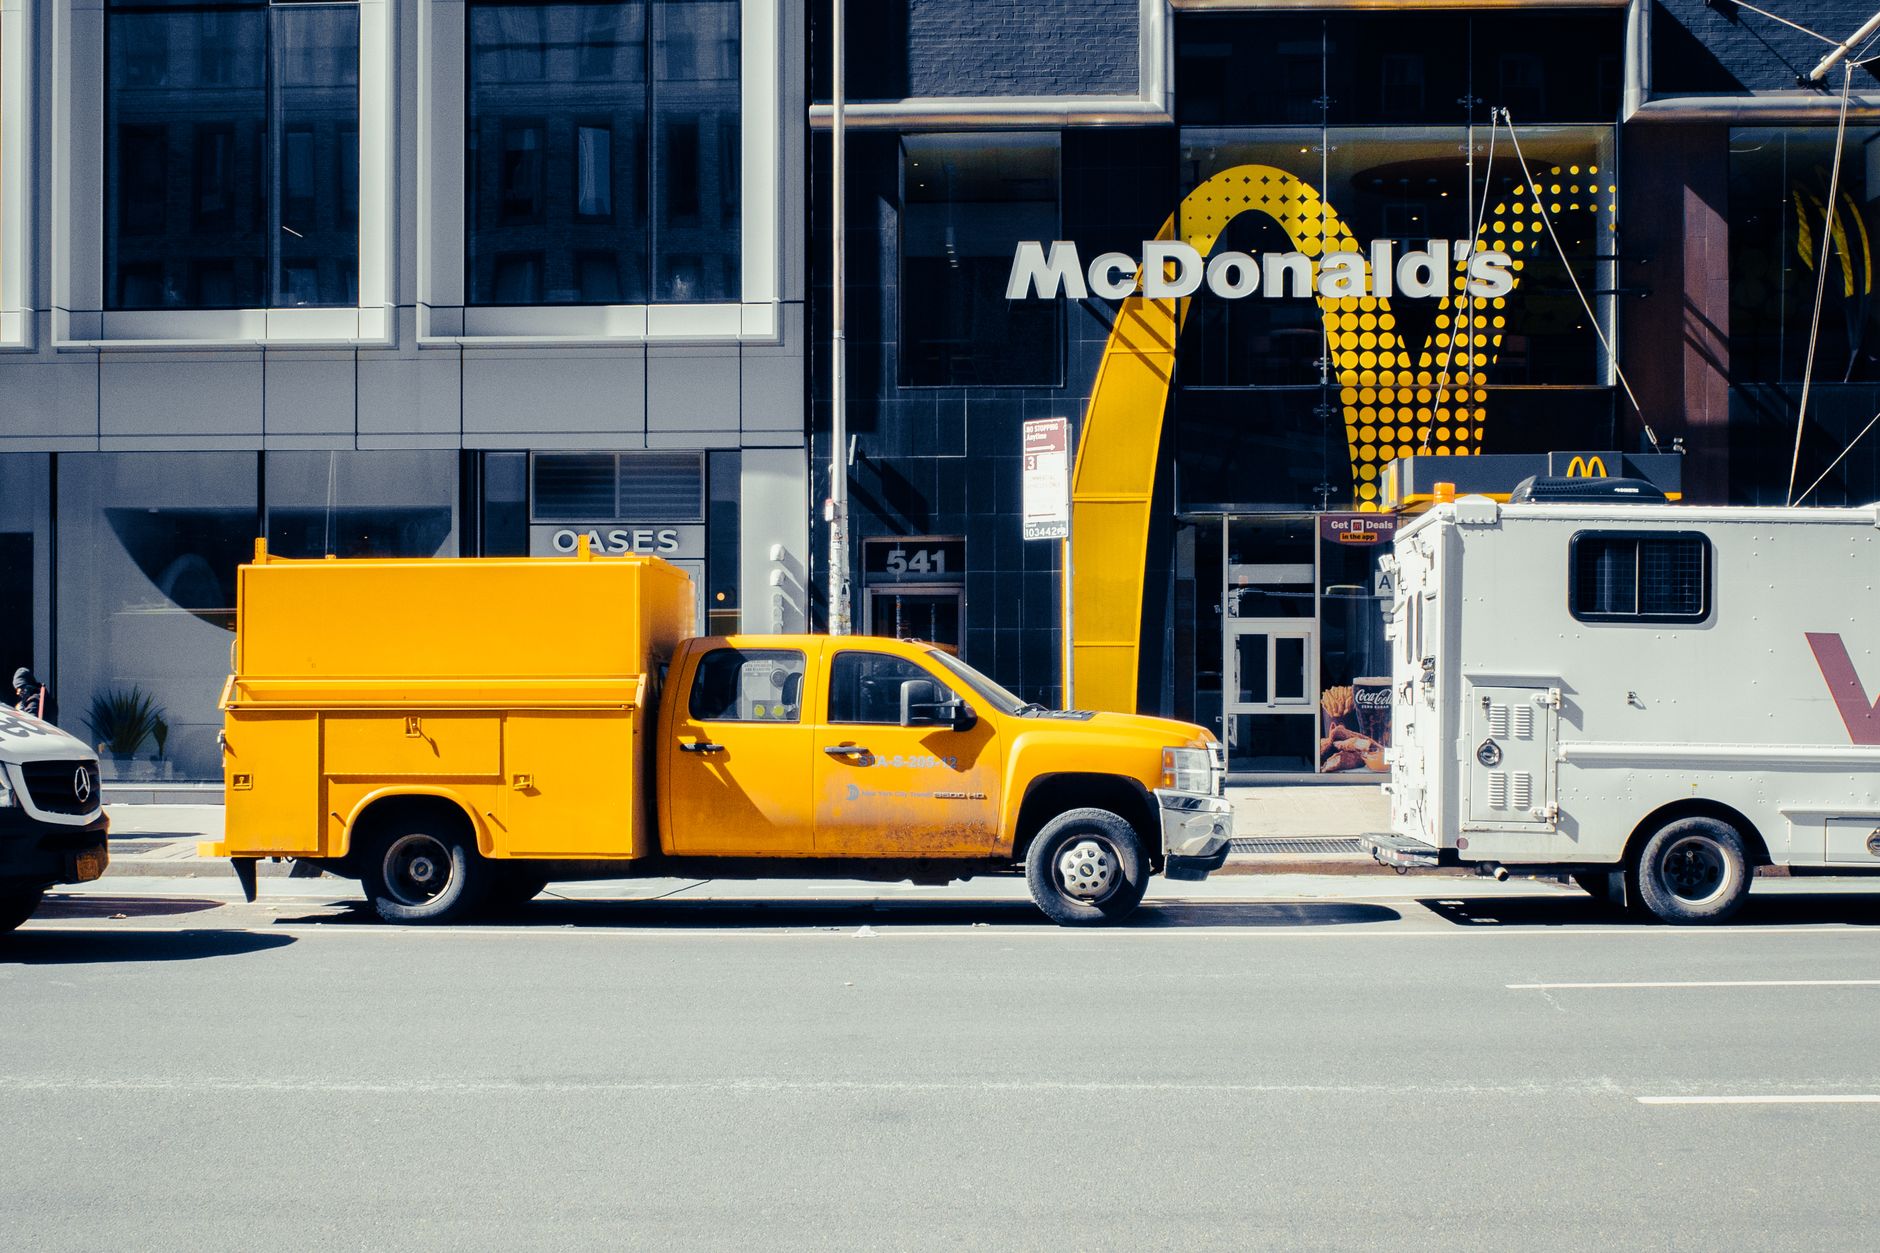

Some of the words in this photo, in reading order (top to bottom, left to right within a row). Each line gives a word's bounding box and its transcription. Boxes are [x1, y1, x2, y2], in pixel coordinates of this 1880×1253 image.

[1005, 239, 1516, 300] McDonald's
[1027, 456, 1035, 470] 3
[1331, 521, 1349, 529] Get
[1366, 520, 1393, 529] Deals
[552, 529, 679, 553] OASES
[886, 550, 945, 575] 541
[1379, 575, 1391, 589] A
[1355, 689, 1392, 704] Coca-Col
